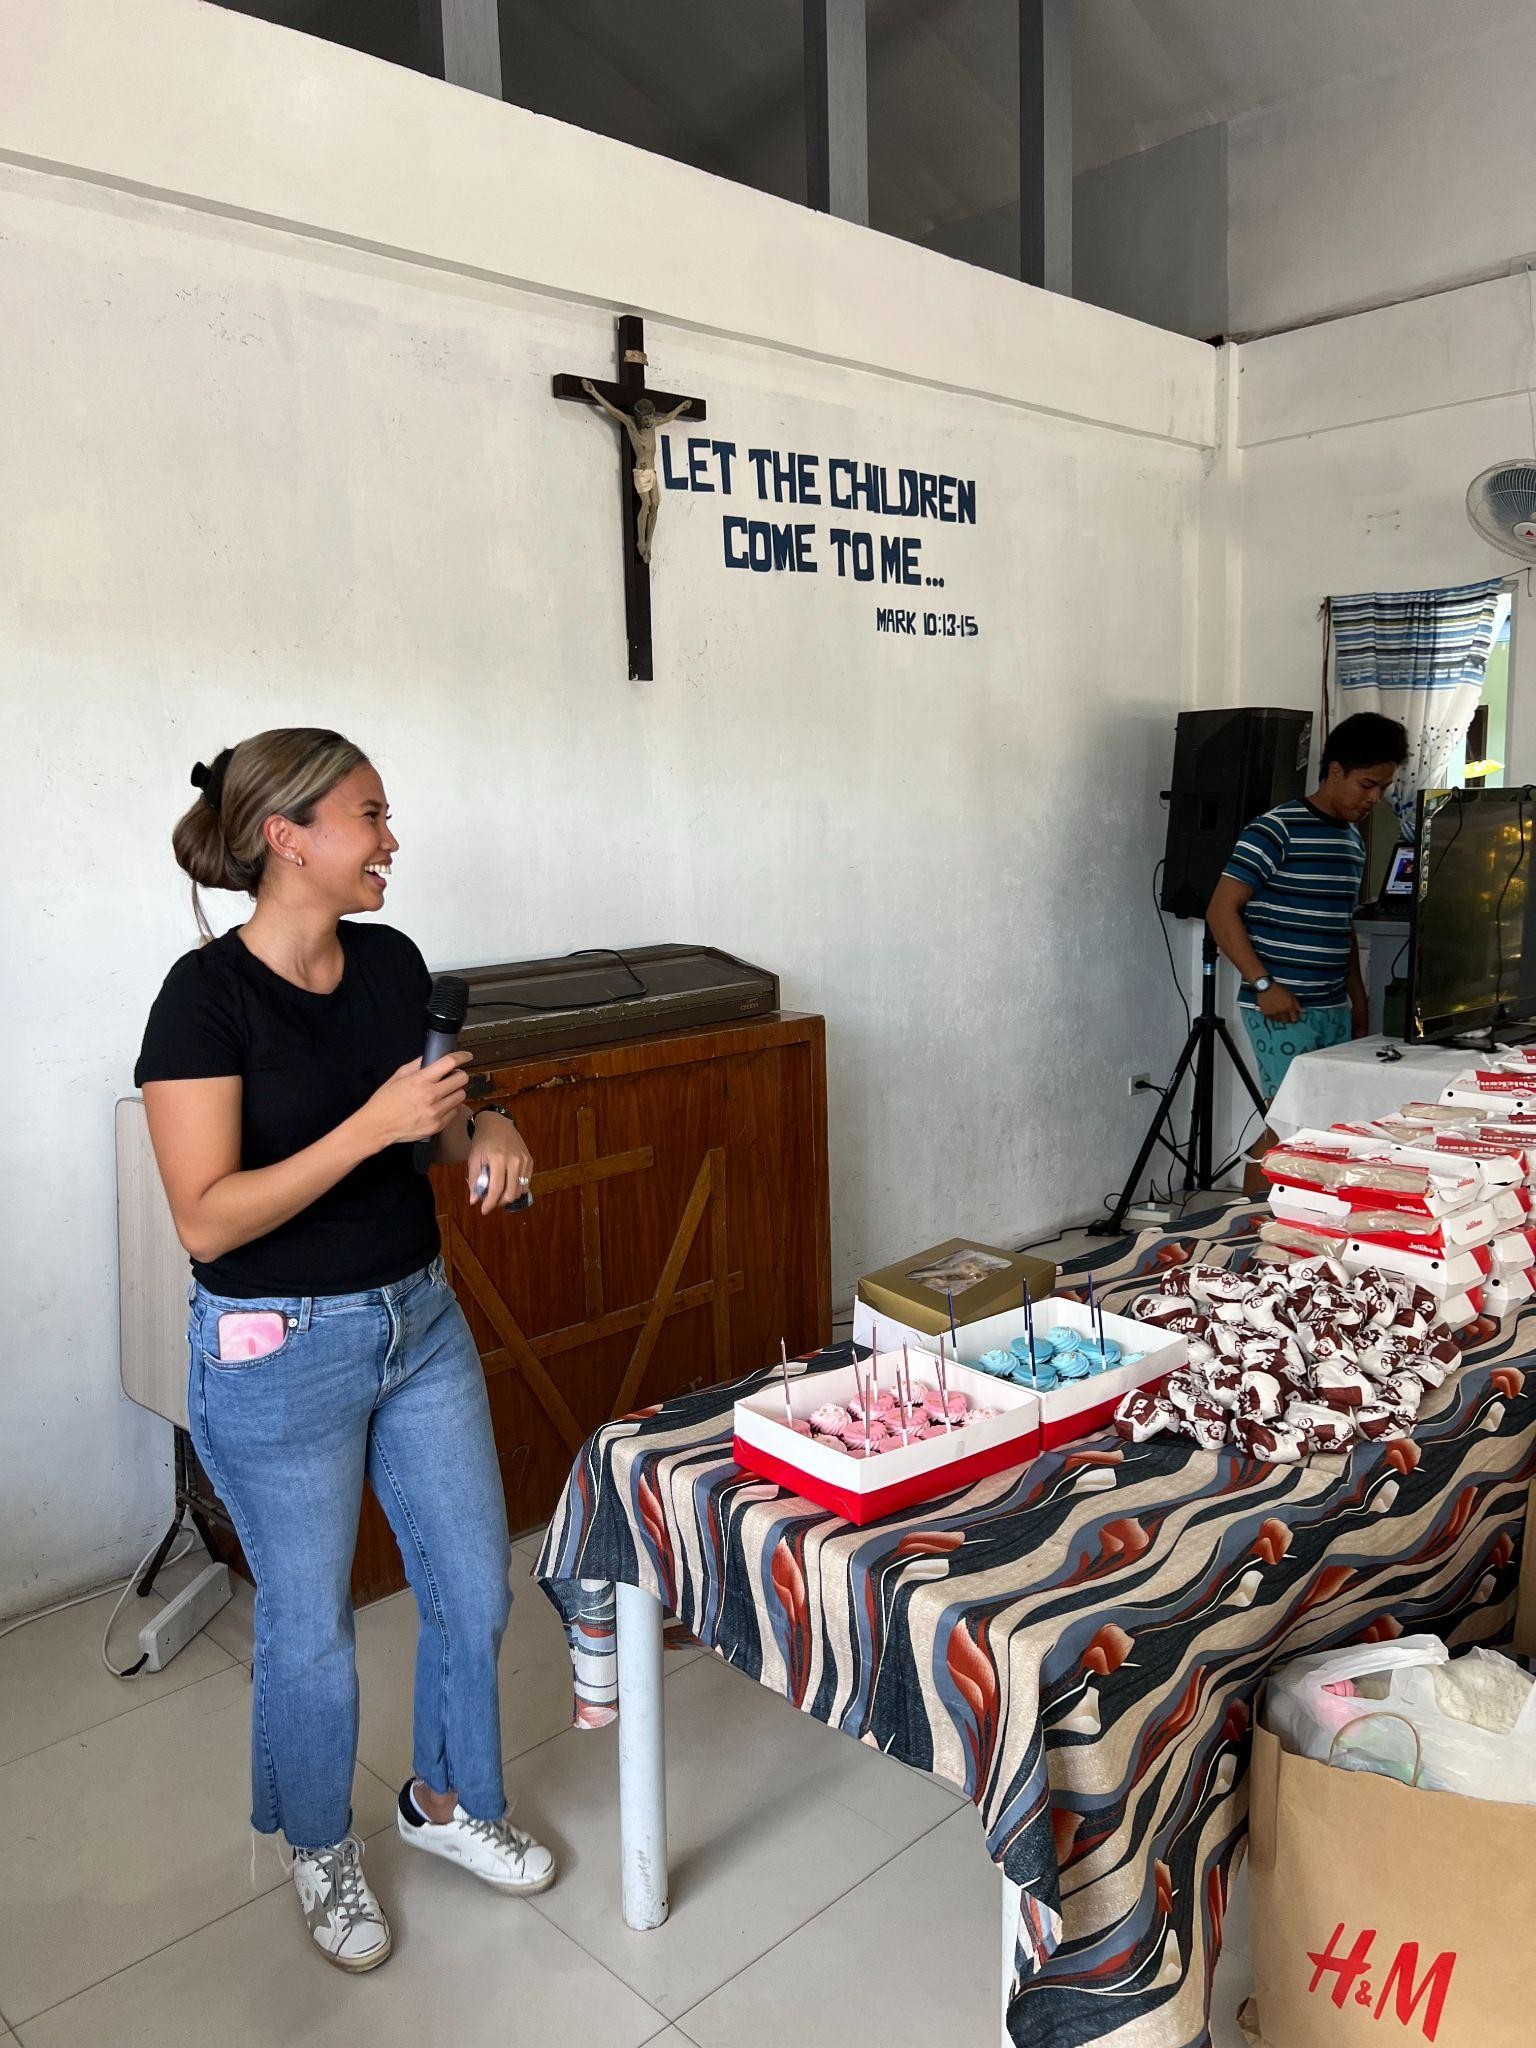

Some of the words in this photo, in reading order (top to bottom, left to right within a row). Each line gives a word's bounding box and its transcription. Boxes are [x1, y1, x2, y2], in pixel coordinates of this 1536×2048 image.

[661, 435, 736, 494] LET
[749, 448, 821, 505] THE
[829, 458, 976, 524] CHILDREN
[723, 515, 817, 573] COME
[830, 528, 874, 582] TO
[881, 535, 944, 588] ME...
[876, 607, 916, 635] MARK
[923, 613, 978, 637] 10:13-15
[1395, 1203, 1427, 1214] Jollibee
[1408, 1242, 1439, 1255] Jollibee
[1306, 1922, 1457, 2042] H&M
